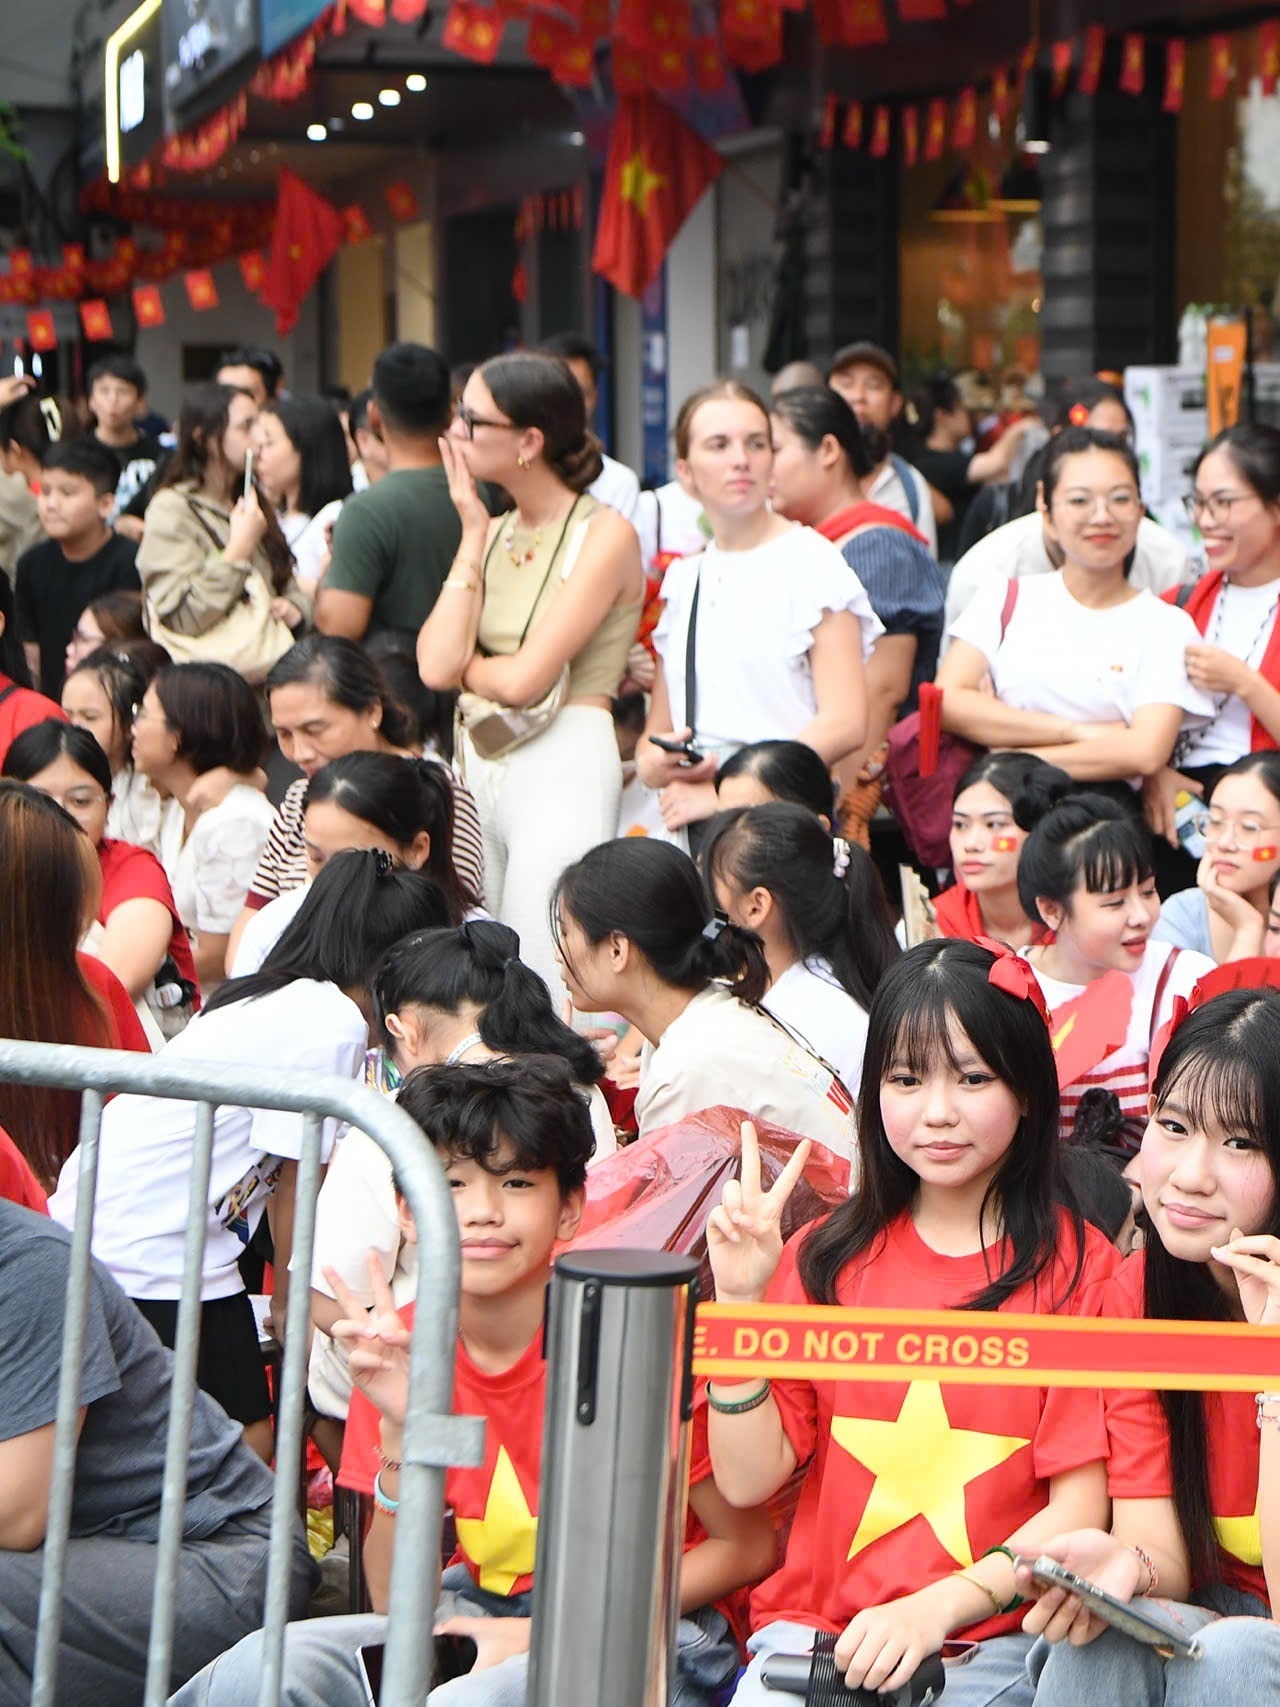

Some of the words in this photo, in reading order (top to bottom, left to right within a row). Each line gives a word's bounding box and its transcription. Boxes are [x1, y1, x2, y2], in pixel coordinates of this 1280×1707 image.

[733, 1327, 790, 1359] DO
[803, 1328, 885, 1361] NOT
[896, 1333, 1030, 1367] CROSS
